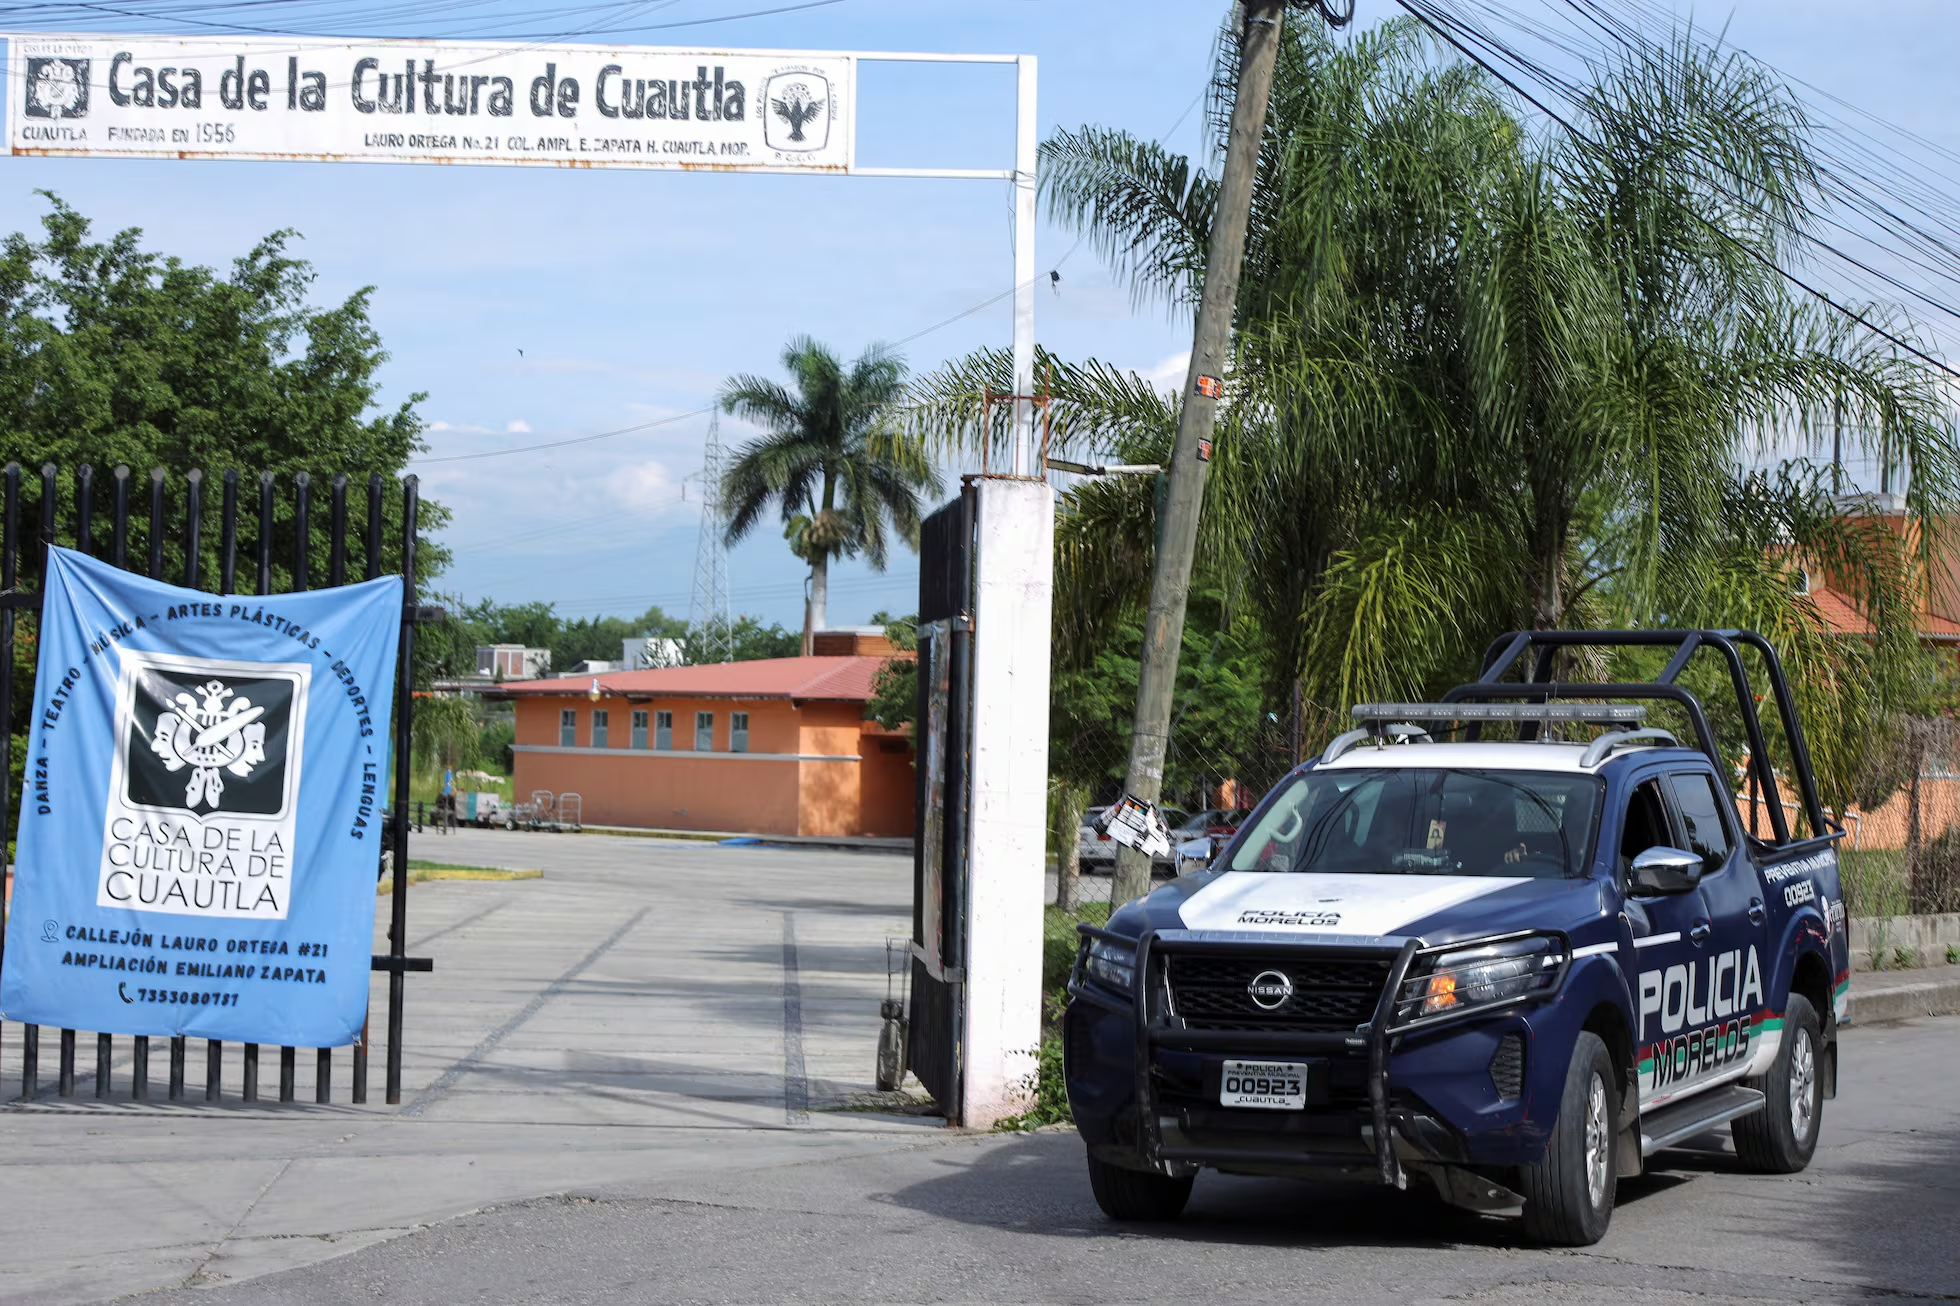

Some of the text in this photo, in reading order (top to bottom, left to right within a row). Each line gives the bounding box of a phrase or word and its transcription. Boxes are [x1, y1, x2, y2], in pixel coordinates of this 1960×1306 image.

[108, 51, 203, 110] Casa
[220, 54, 270, 112] de
[287, 55, 327, 113] la
[351, 56, 514, 118] Cultura
[530, 62, 580, 119] de
[595, 64, 745, 122] Cuautla
[22, 126, 88, 141] CUAUTLA
[171, 128, 190, 143] EN
[196, 122, 236, 144] 1956
[364, 133, 404, 148] LAURO
[408, 133, 457, 149] ORTEGA
[507, 136, 535, 151] COL.
[594, 138, 642, 154] ZAPATA
[167, 603, 222, 621] ARTES
[230, 605, 321, 650] PLÁSTICAS
[90, 614, 147, 656] MÚSICA
[42, 667, 82, 730] TEATRO
[331, 659, 374, 738] DEPORTES
[35, 757, 52, 816] DANZA
[350, 762, 377, 840] LENGUAS
[111, 817, 285, 854] CASA DE LA
[107, 843, 285, 878] CULTURA DE
[106, 870, 279, 912] CUAUTLA
[1783, 879, 1815, 908] 00923
[1236, 916, 1340, 926] MORELOS
[66, 925, 328, 958] CALLEJÓN LAURO ORTEGA #21
[62, 950, 326, 984] AMPLIACIÓN EMILIANO ZAPATA
[1247, 985, 1294, 996] NISSAN
[1638, 944, 1764, 1042] POLICIA
[1651, 1014, 1752, 1090] MORELOS
[1226, 1077, 1300, 1096] 00923
